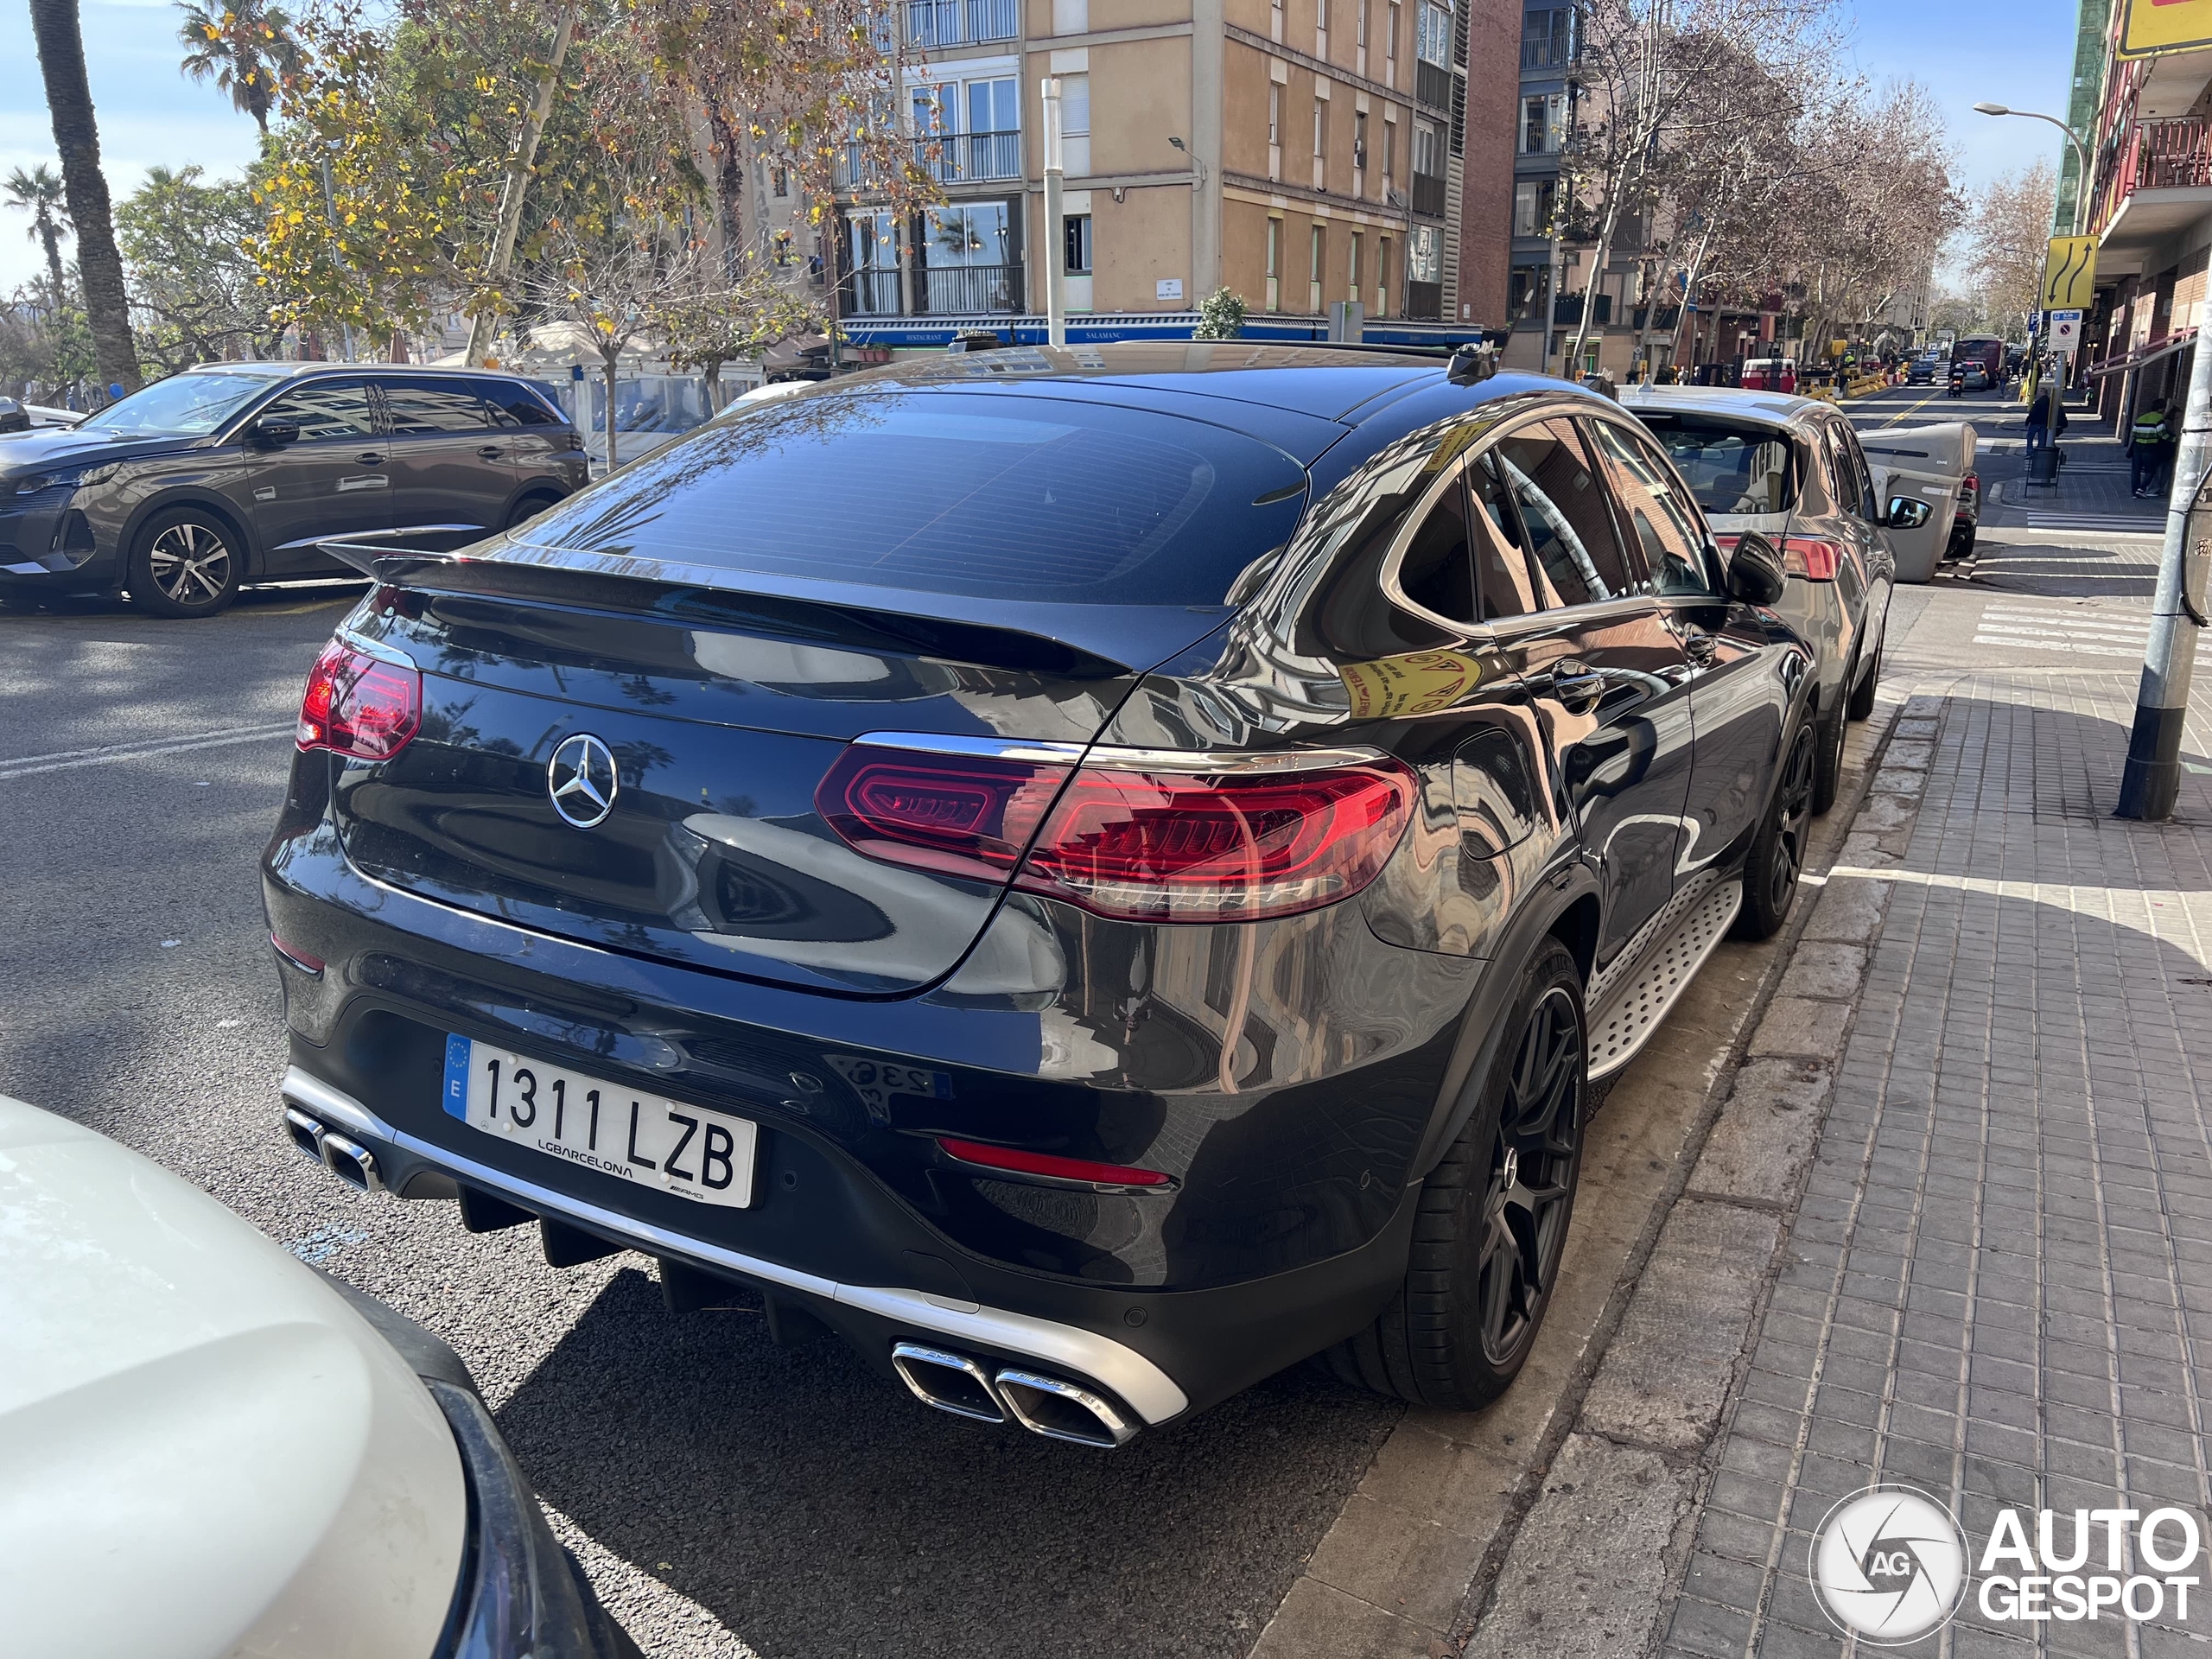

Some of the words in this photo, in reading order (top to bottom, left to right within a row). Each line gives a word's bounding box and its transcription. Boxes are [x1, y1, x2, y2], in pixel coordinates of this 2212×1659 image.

[450, 1079, 461, 1098] E
[487, 1058, 601, 1152] 1311
[626, 1101, 734, 1191] LZB
[538, 1139, 633, 1179] LGBARCELONA
[677, 1186, 704, 1200] AMG
[921, 1349, 958, 1363] AMG
[1026, 1374, 1065, 1390] AMG
